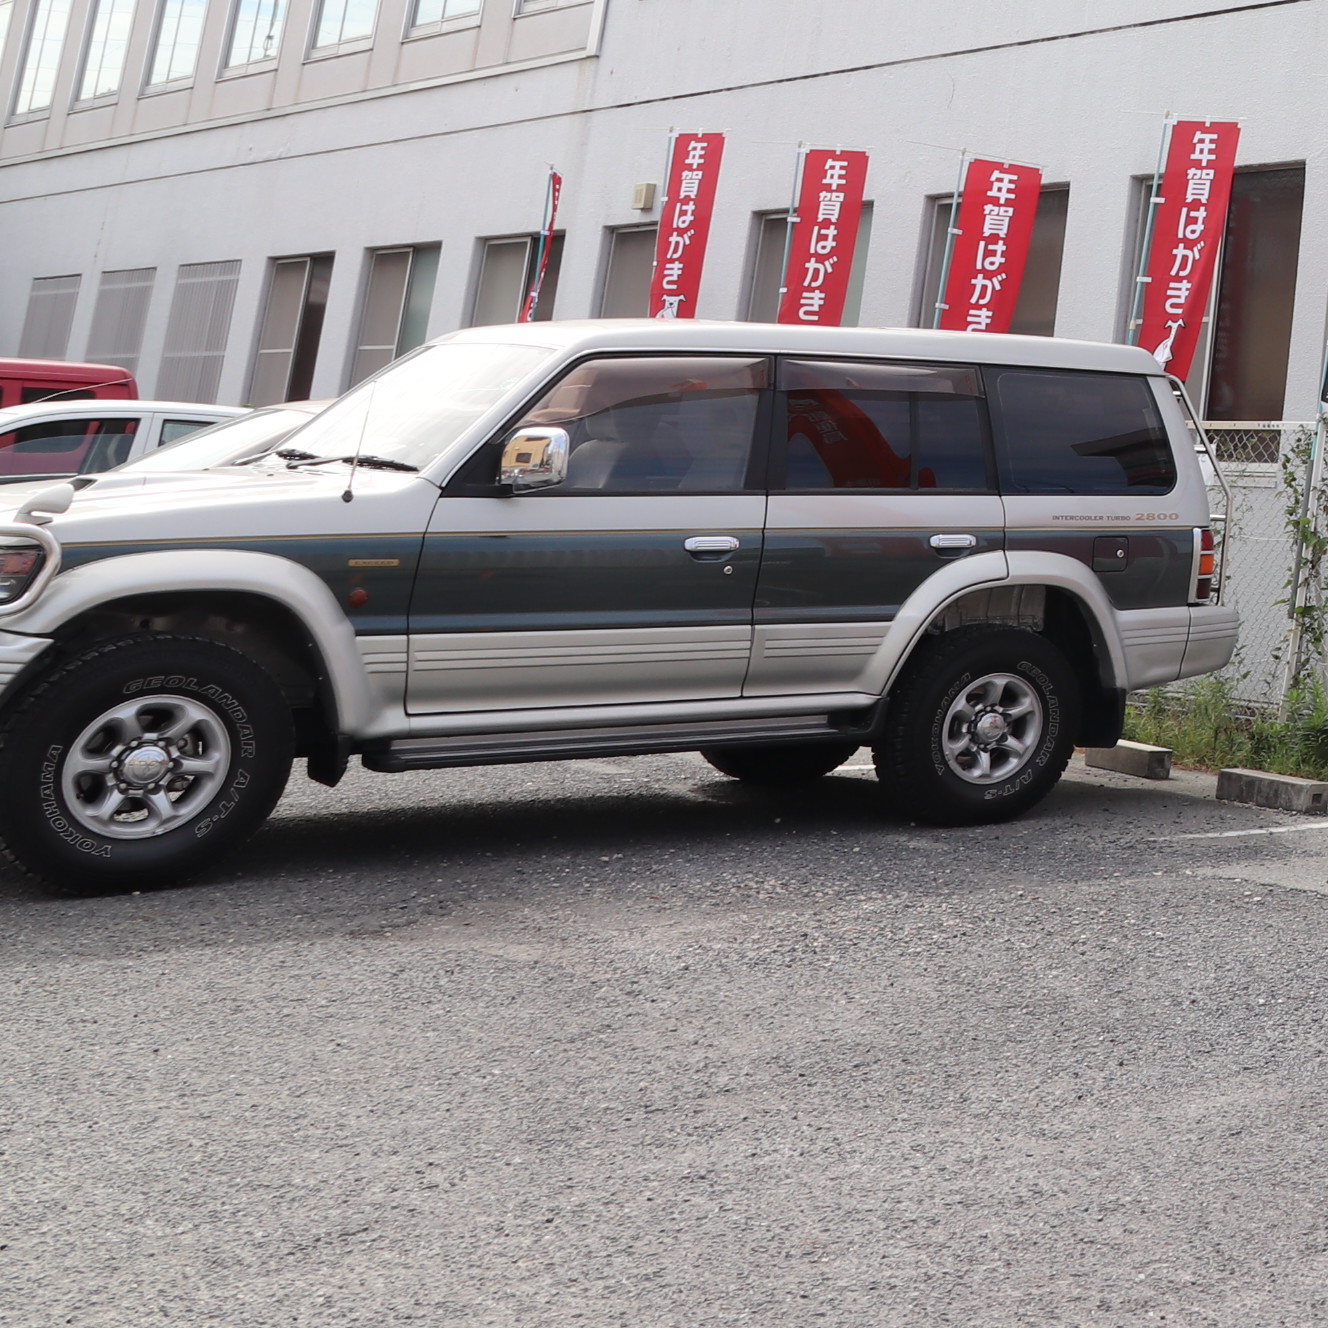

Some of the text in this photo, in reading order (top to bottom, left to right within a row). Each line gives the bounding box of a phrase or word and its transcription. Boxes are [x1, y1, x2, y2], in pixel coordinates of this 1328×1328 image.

[662, 140, 708, 290] 年賀はがき
[798, 158, 849, 322] 年賀はがき
[966, 170, 1018, 332] 年賀はがき
[1164, 130, 1217, 317] 年賀はがき
[1135, 512, 1179, 521] 2800
[122, 675, 256, 759] GEOLANDAR
[40, 744, 113, 858] YOKOHAMA
